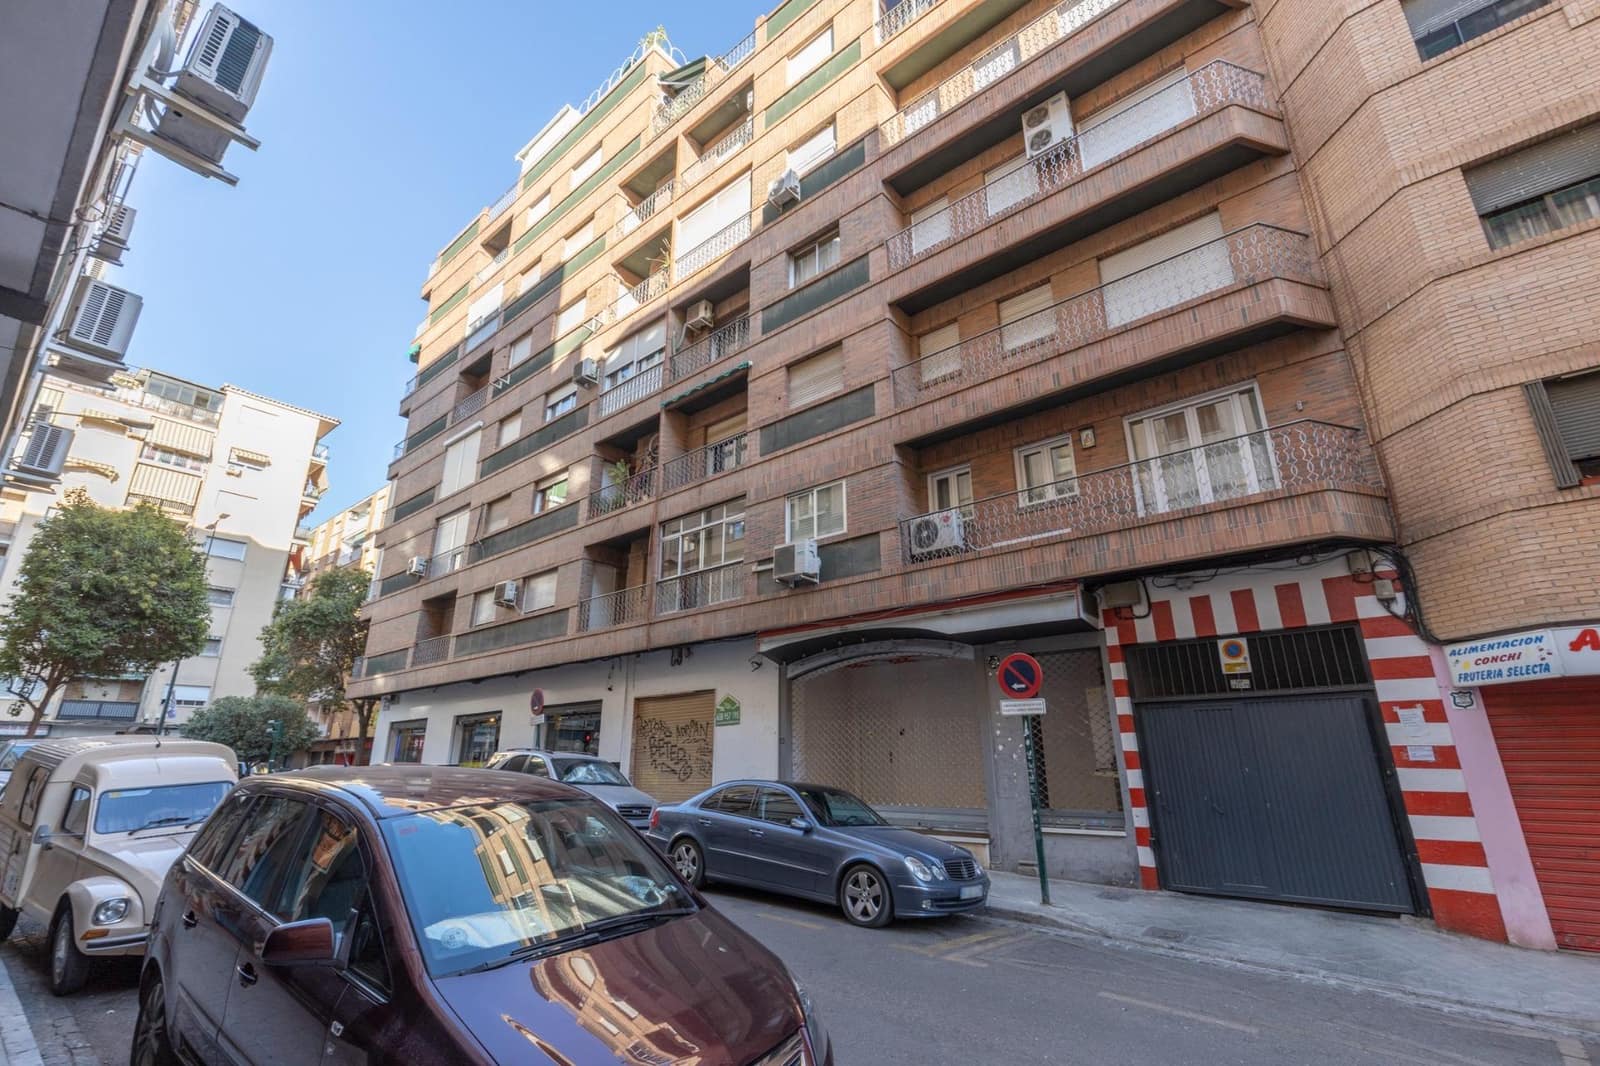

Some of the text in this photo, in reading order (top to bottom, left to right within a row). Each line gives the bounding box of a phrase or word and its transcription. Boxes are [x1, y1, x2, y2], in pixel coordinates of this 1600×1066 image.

[1450, 635, 1544, 657] ALIMENTACION
[1474, 652, 1522, 666] CONCHI
[1458, 662, 1551, 683] FRUTERIA SELECTA
